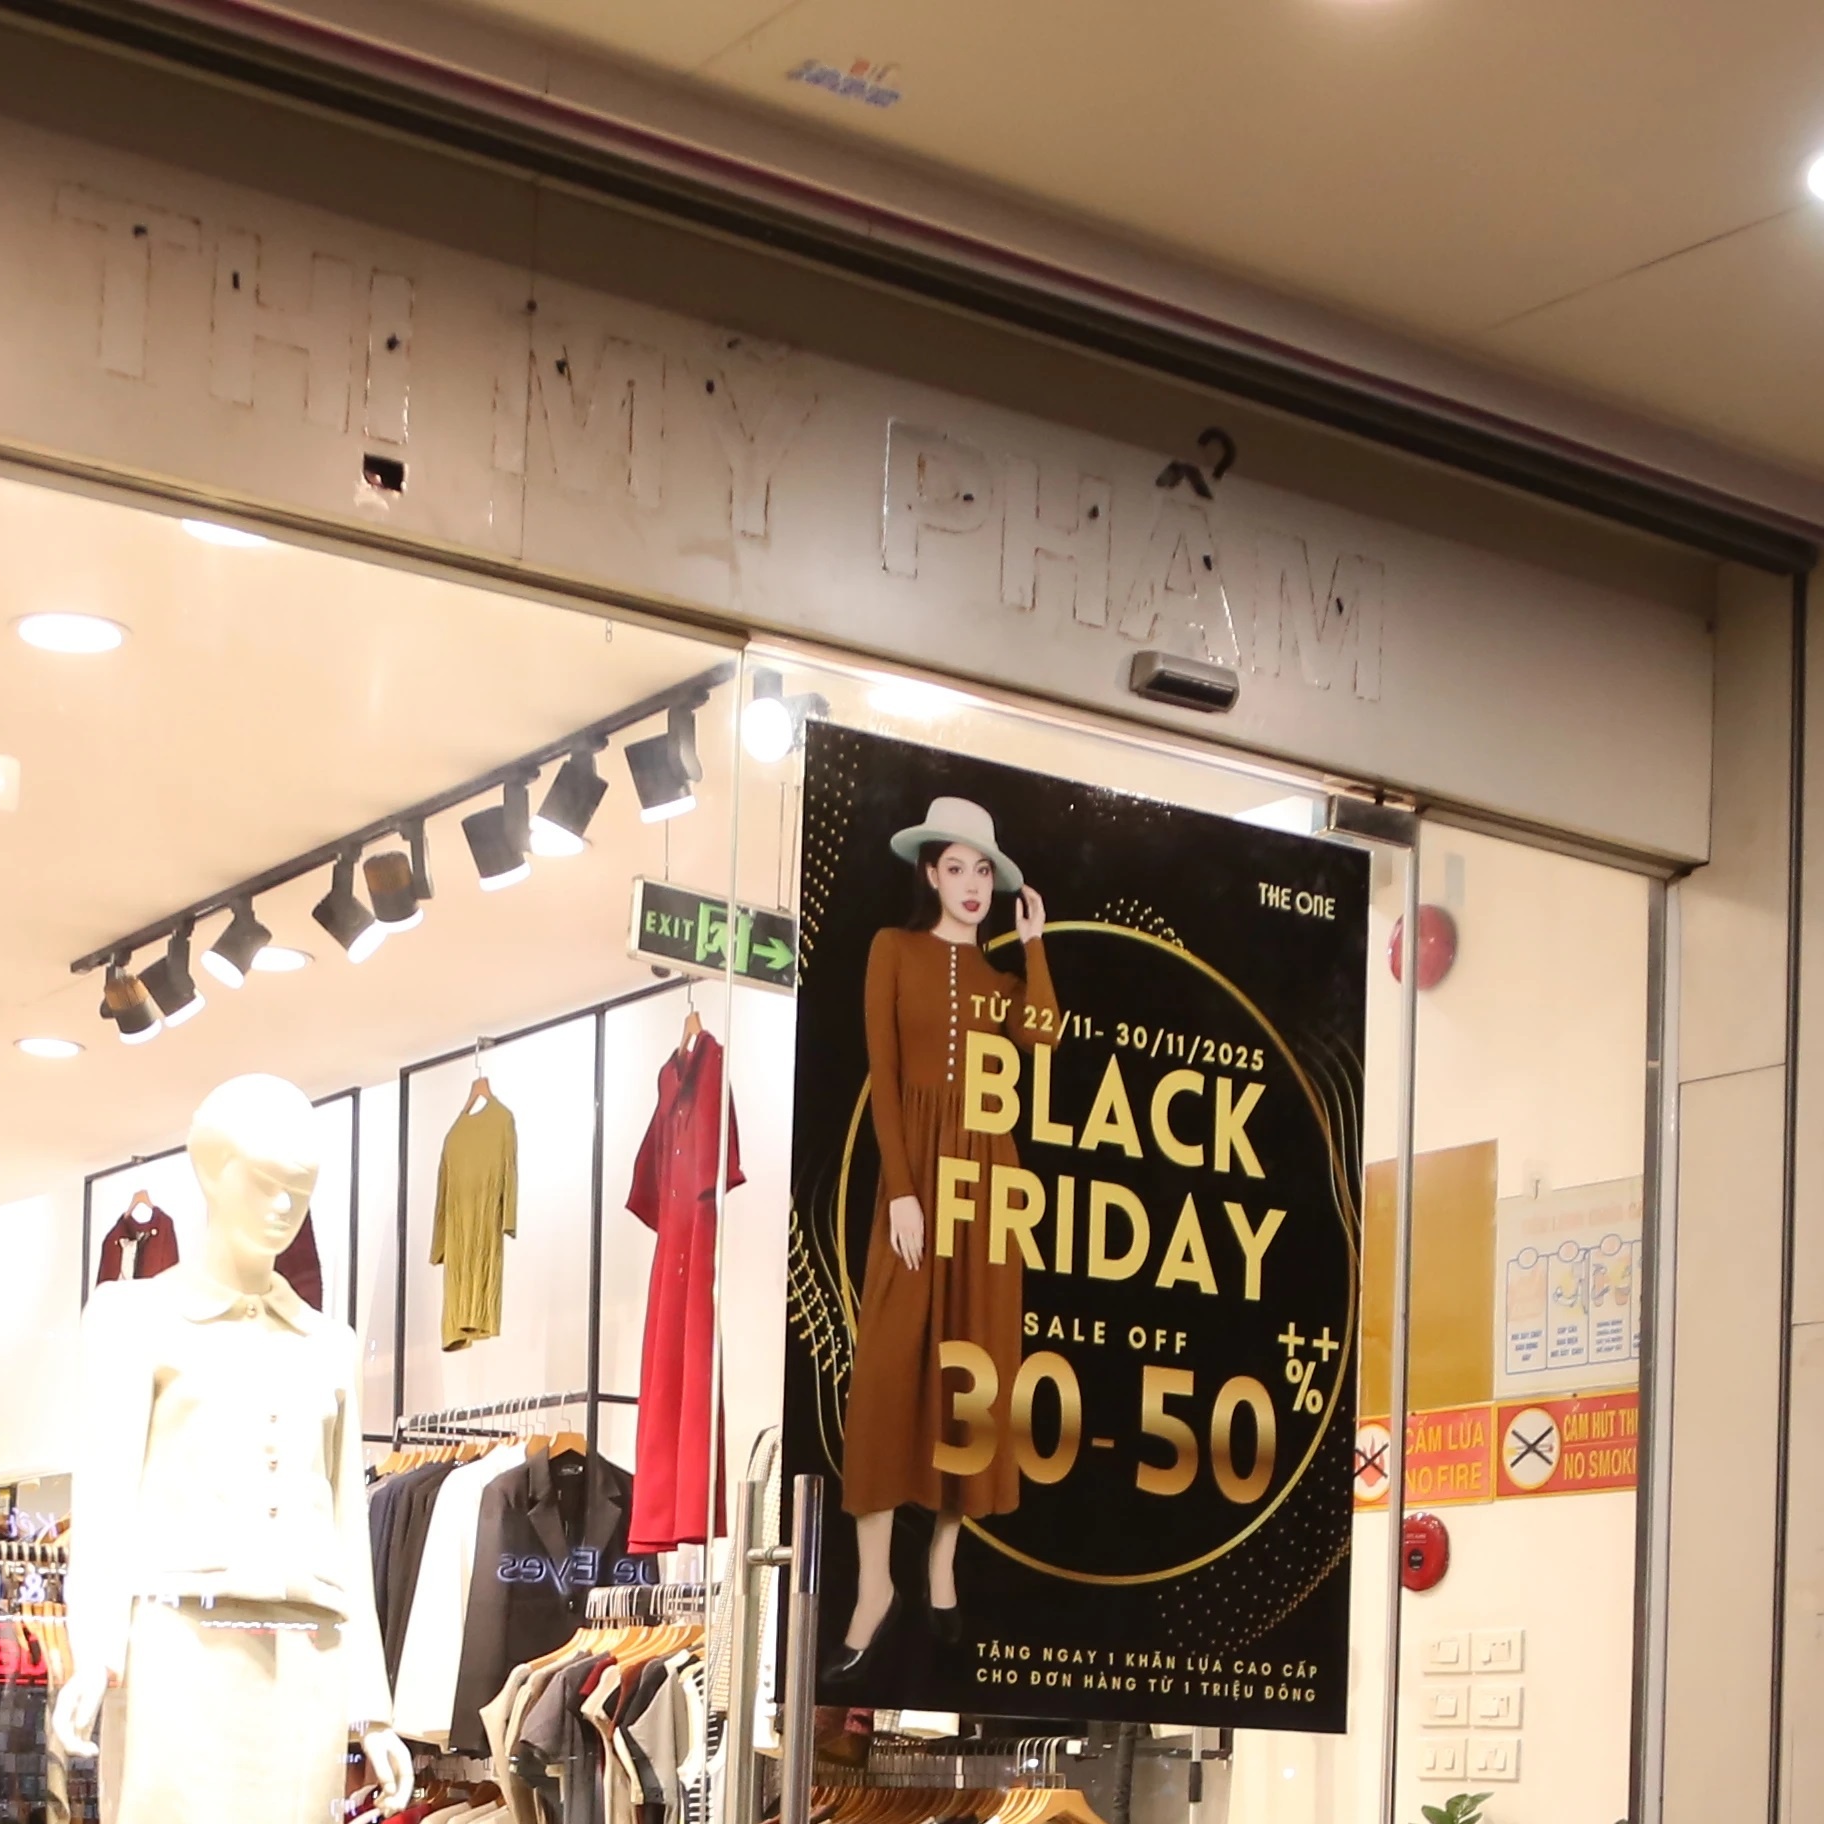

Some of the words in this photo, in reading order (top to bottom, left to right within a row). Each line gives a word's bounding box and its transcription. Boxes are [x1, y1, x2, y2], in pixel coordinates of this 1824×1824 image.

[1258, 882, 1291, 911] THE
[1295, 890, 1336, 920] ONE
[645, 910, 694, 941] EXIT
[970, 990, 1012, 1023] TỪ
[1116, 1022, 1265, 1072] 30/11/2025
[963, 1030, 1267, 1180] BLACK
[935, 1155, 1287, 1302] FRIDAY
[1024, 1312, 1107, 1346] SALE
[1129, 1325, 1189, 1355] OFF
[1405, 1416, 1443, 1455] CẤM
[1448, 1413, 1484, 1450] LỬA
[1563, 1403, 1588, 1443] CẤM
[1592, 1403, 1615, 1441] HÚT
[1619, 1407, 1639, 1435] TH
[1405, 1468, 1432, 1494] NO
[1439, 1462, 1483, 1491] FIRE
[1564, 1453, 1585, 1481] NO
[1589, 1449, 1637, 1480] SMOKI
[977, 1667, 1019, 1684] CHO
[1084, 1670, 1137, 1691] HÀNG
[1043, 1647, 1097, 1665] NGAY
[1233, 1660, 1272, 1677] CAO
